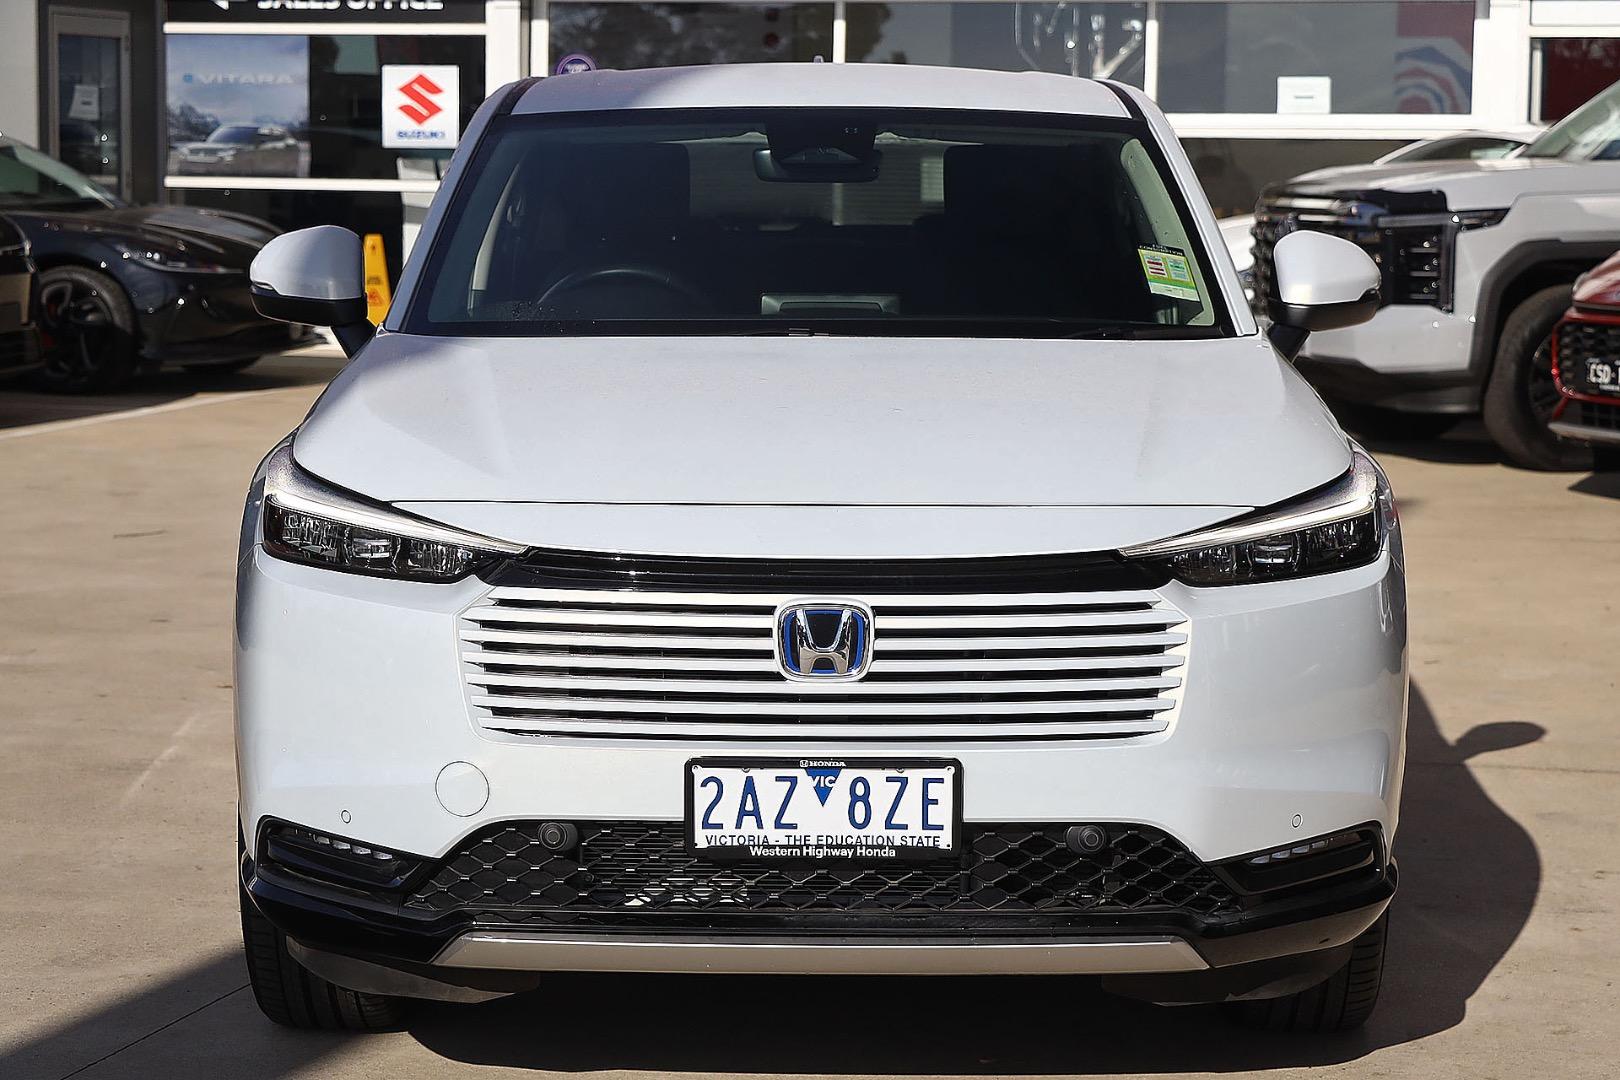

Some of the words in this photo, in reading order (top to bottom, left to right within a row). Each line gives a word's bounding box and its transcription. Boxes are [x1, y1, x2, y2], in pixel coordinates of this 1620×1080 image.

[807, 775, 837, 788] VIC
[700, 776, 798, 830] 2AZ
[847, 776, 945, 831] 8ZE
[705, 834, 770, 846] VICTORIA
[784, 834, 811, 846] THE
[816, 834, 895, 847] EDUCATION
[900, 835, 942, 847] STATE
[749, 846, 800, 856] Western
[802, 846, 854, 858] Highway
[856, 847, 896, 857] Honda
